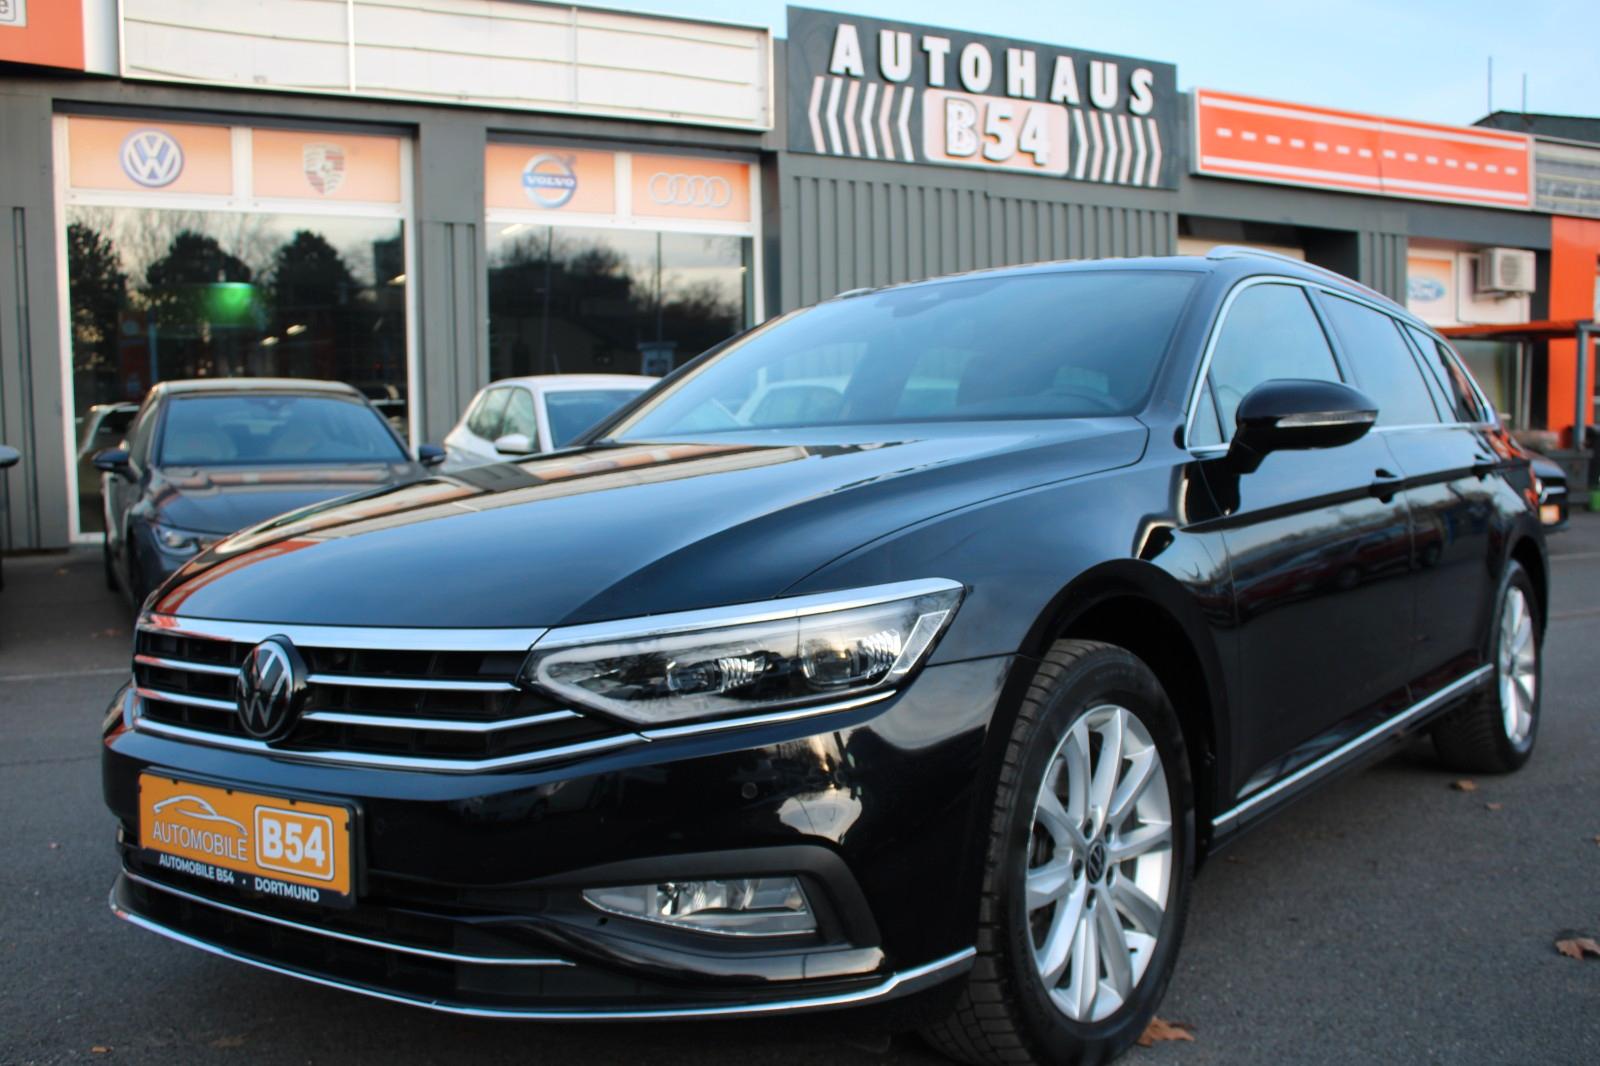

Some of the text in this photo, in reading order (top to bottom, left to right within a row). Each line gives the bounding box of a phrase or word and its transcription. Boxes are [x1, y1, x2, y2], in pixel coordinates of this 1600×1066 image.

[829, 22, 1155, 117] AUTOHAUS
[945, 97, 1052, 167] B54
[526, 175, 575, 188] VOLVO
[152, 820, 249, 862] AUTOMOBILE
[262, 817, 326, 868] B54
[158, 853, 320, 903] AUTOMOBILE B54 DORTMUND
